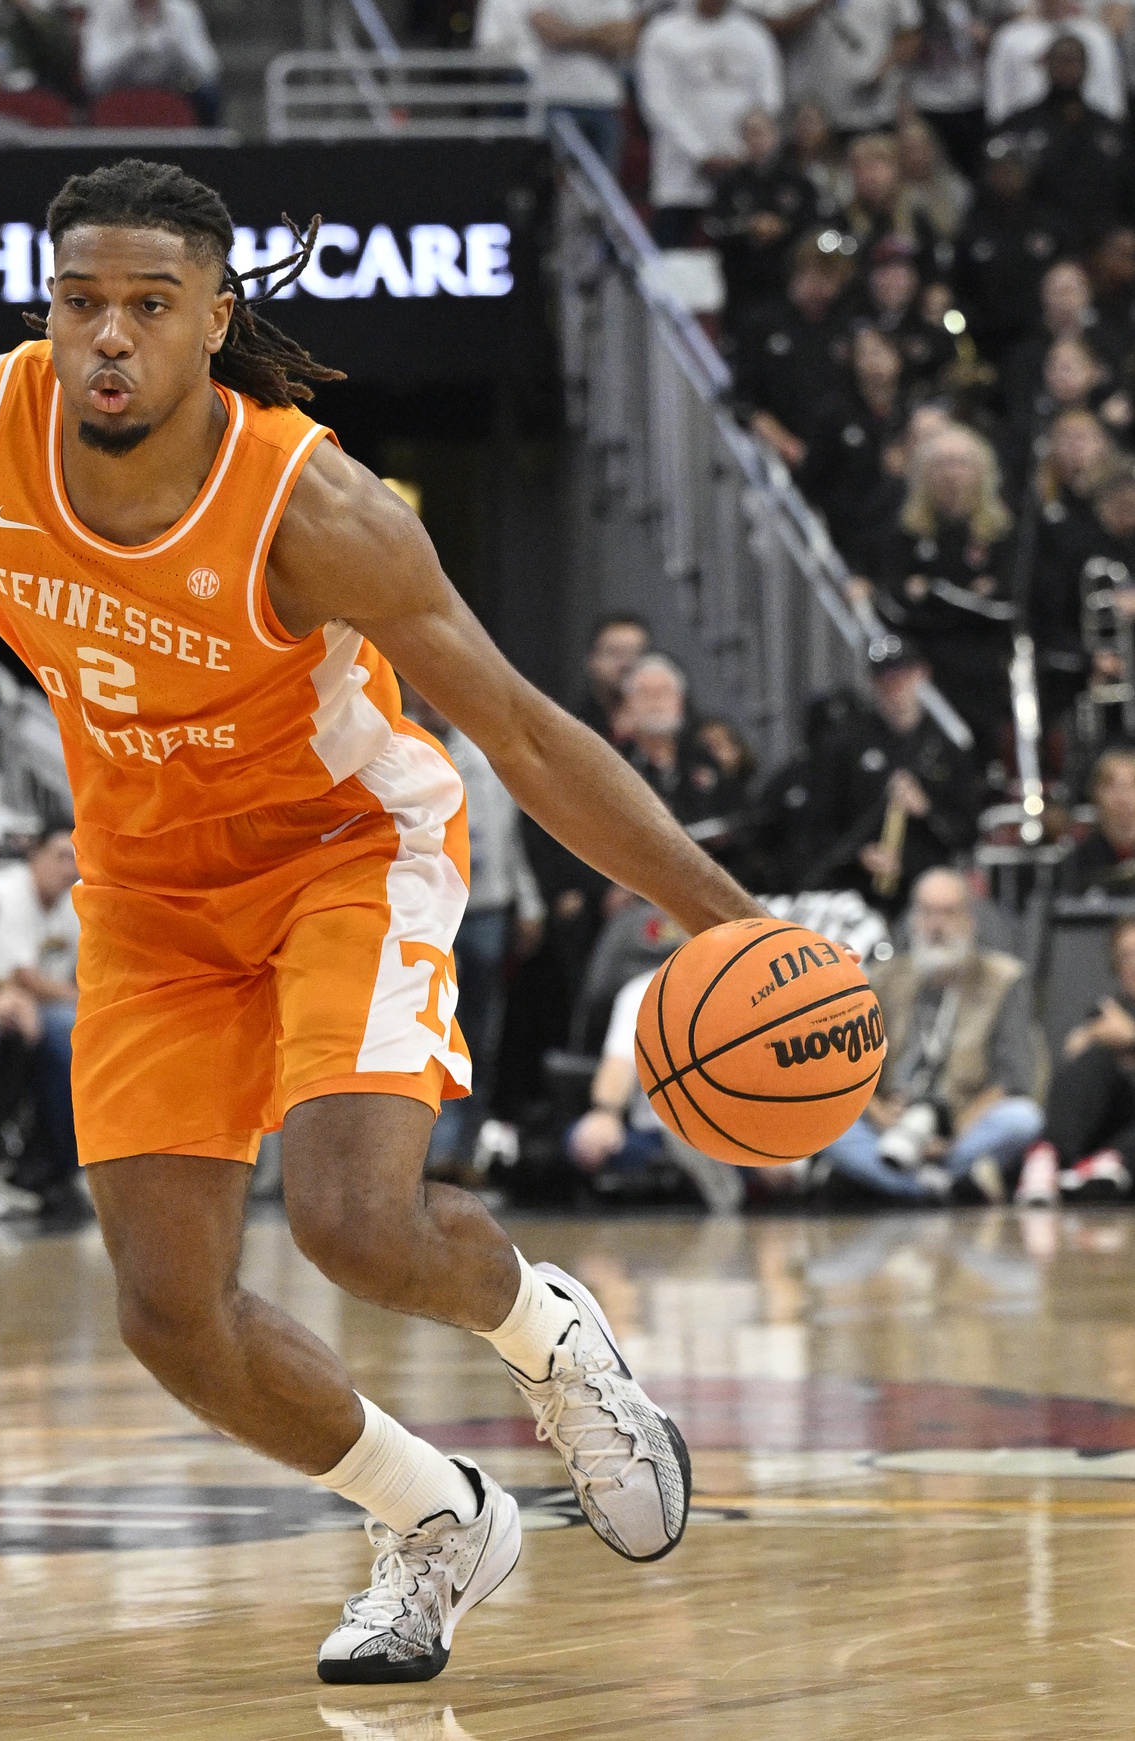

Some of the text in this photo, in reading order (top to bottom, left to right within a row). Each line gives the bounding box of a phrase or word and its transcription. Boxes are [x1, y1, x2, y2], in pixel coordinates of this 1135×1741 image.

[190, 569, 217, 597] SEC
[76, 646, 138, 715] 2
[751, 981, 776, 1008] NXT
[771, 1003, 884, 1068] Wilson
[810, 1017, 828, 1026] BALL
